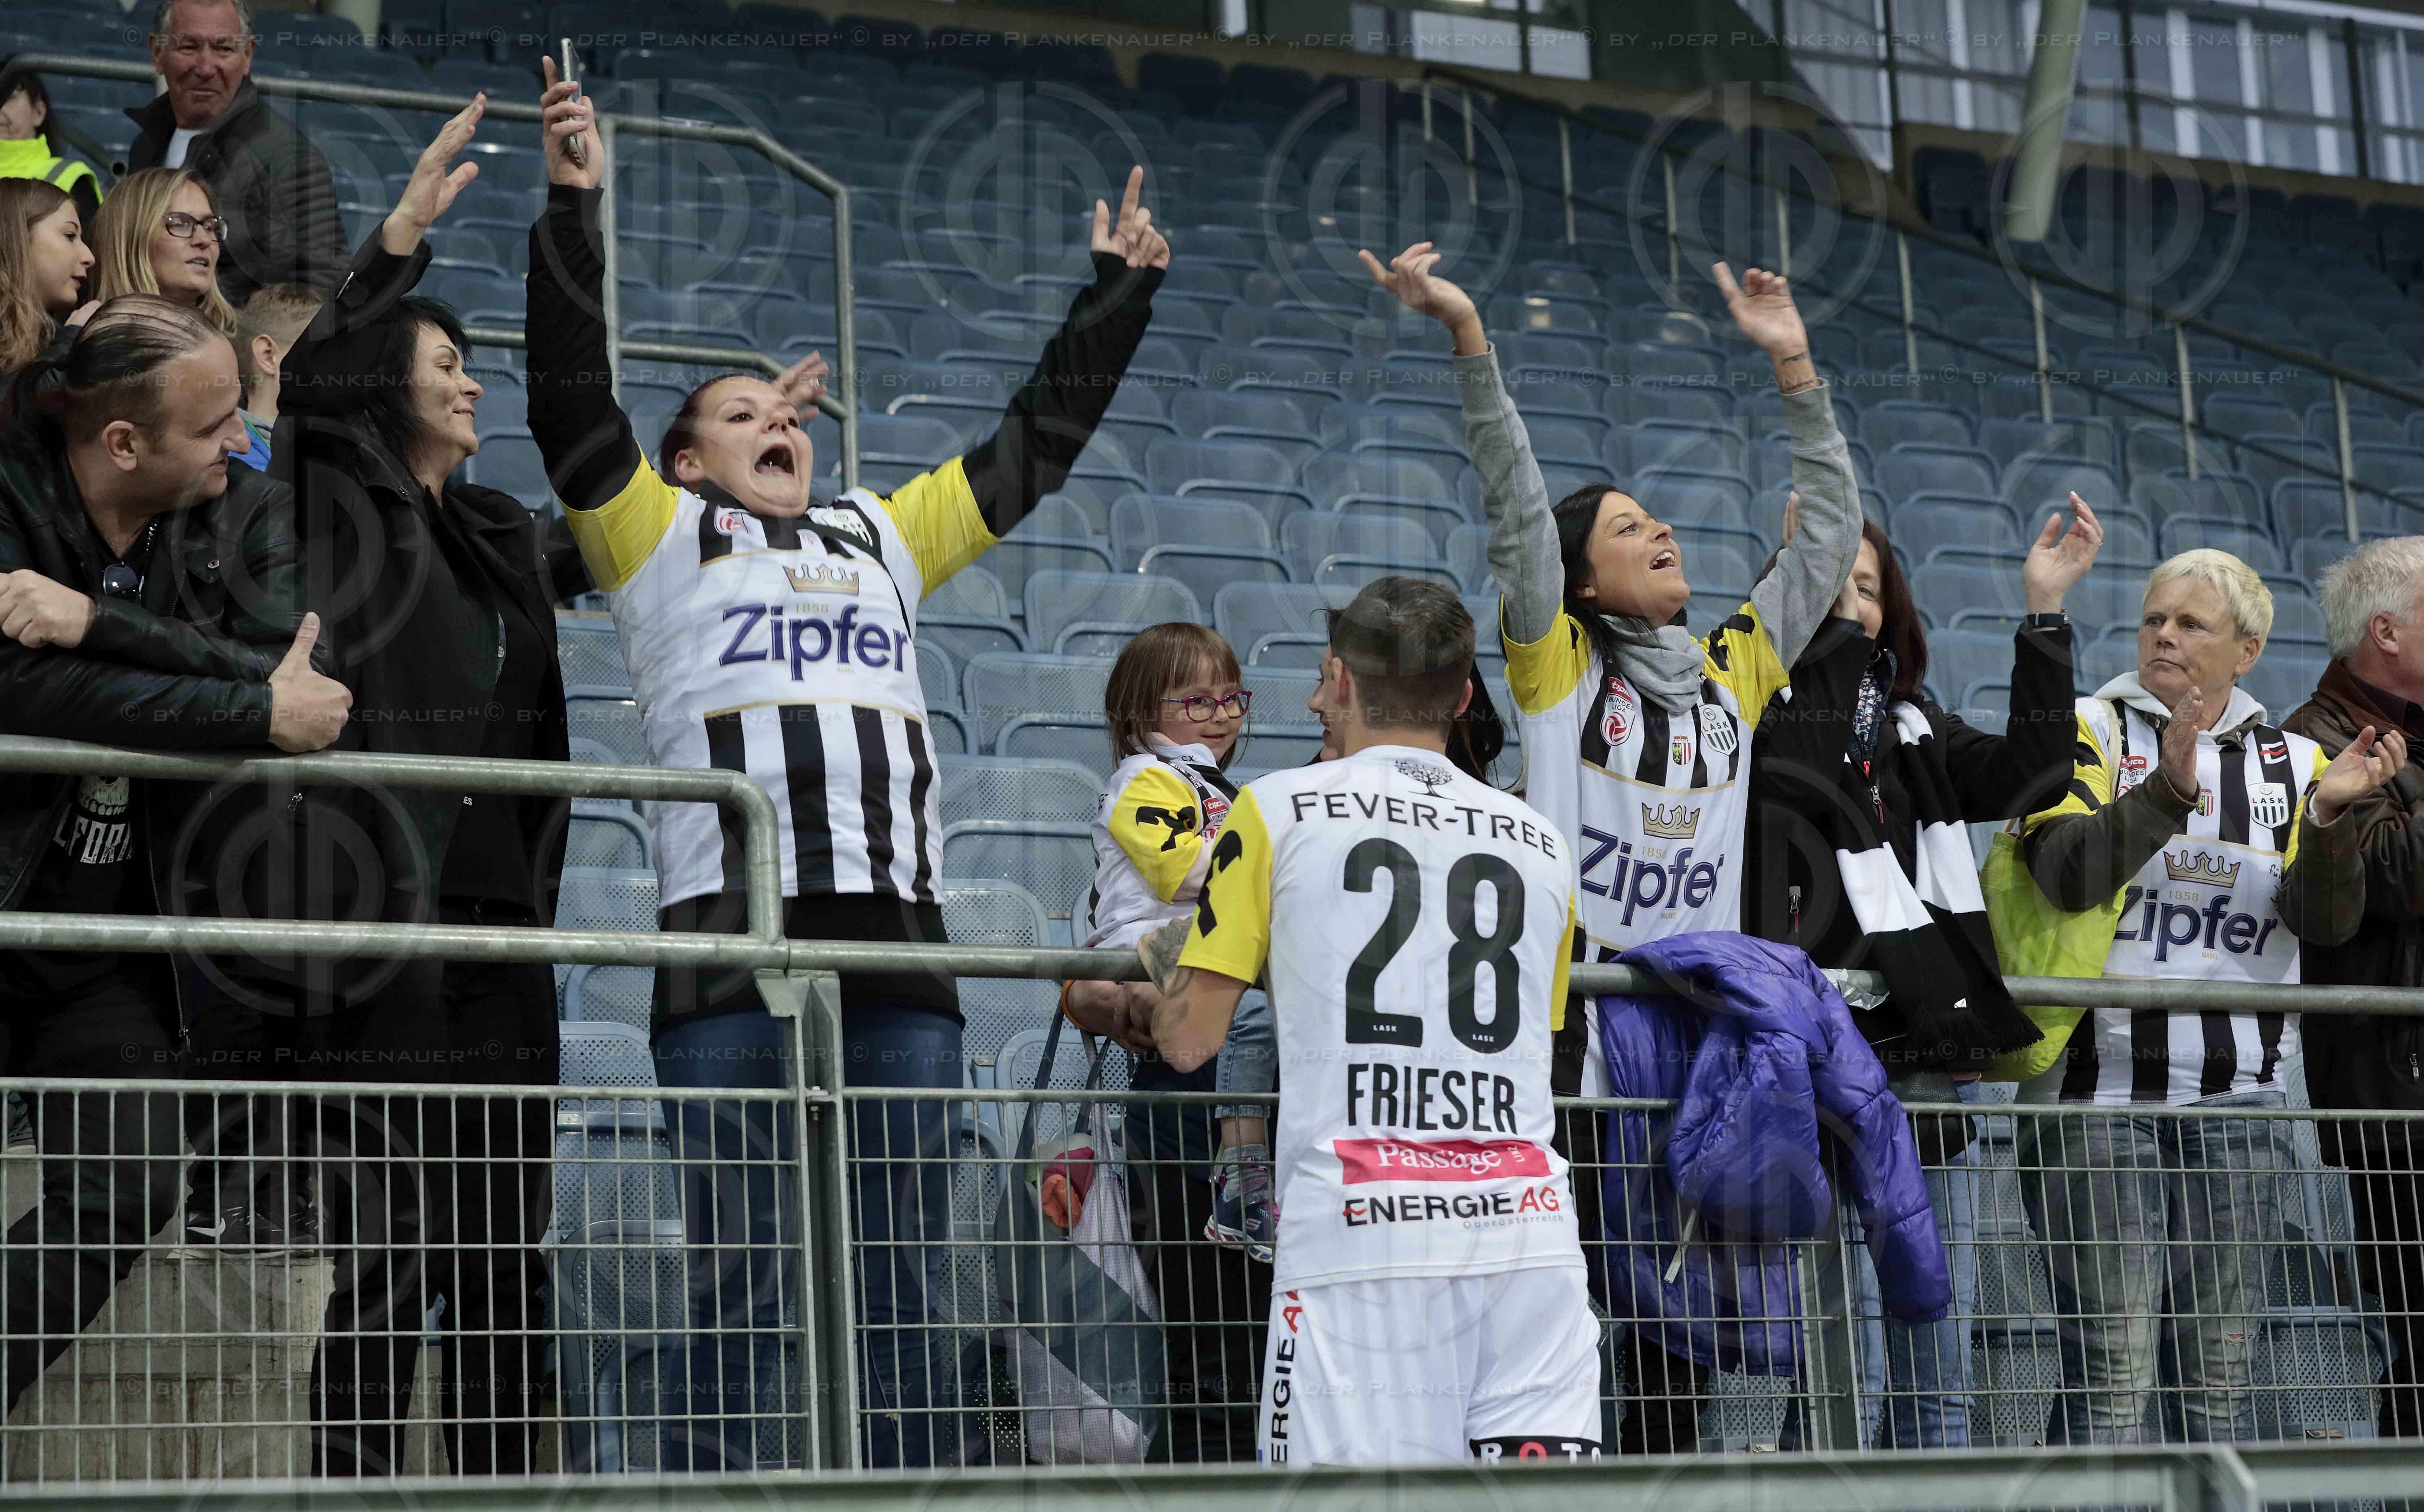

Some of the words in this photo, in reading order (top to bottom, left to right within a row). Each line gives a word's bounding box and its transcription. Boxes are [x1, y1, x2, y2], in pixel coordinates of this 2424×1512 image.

[796, 603, 829, 613] 1858
[719, 603, 907, 681] Zipfer
[1608, 696, 1634, 711] BUNDES
[1612, 703, 1626, 714] LIGA
[1702, 721, 1729, 732] LASK
[463, 796, 472, 805] ES
[1291, 791, 1557, 860] FEVER-TREE
[1642, 846, 1668, 859] 1858
[2169, 890, 2199, 902] 1858
[2113, 885, 2278, 963] Zipfer
[1343, 838, 1525, 1054] 28
[1373, 1024, 1397, 1033] LASK
[1472, 1033, 1494, 1042] LASK
[1348, 1063, 1519, 1135] FRIESER
[1374, 1143, 1502, 1175] Passage
[1463, 1214, 1564, 1230] Oberösterreich
